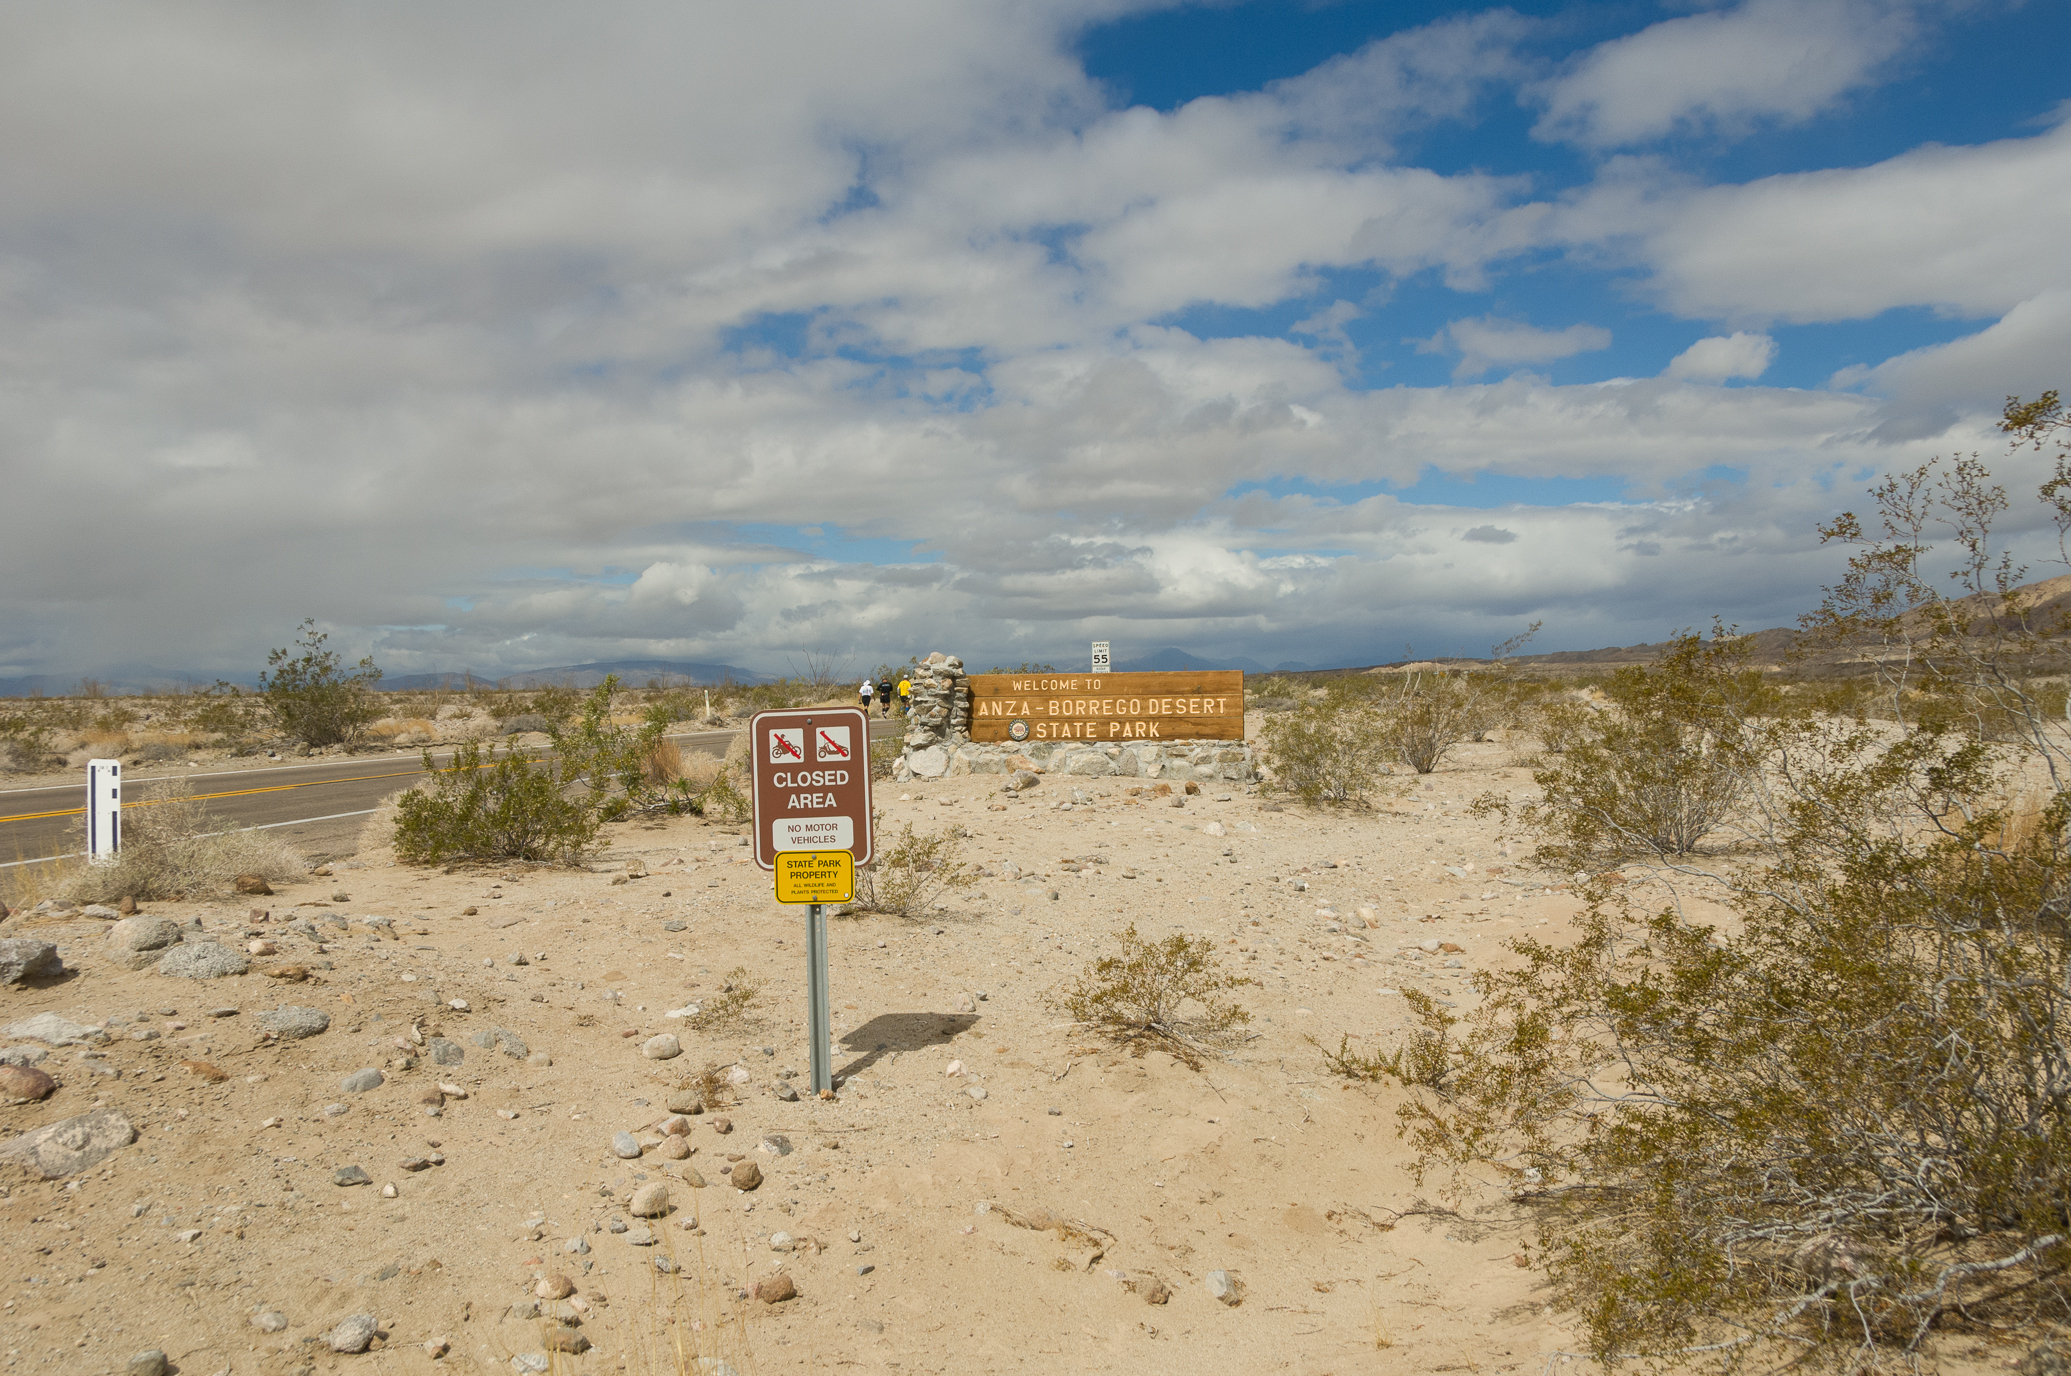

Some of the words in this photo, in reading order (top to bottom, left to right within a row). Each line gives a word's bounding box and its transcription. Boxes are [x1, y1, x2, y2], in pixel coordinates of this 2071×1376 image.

[1093, 654, 1108, 664] 55
[1013, 679, 1078, 691] WELCOME
[1085, 679, 1101, 690] TO
[1149, 698, 1227, 715] DESERT
[1036, 722, 1097, 738] STATE
[1109, 721, 1160, 738] PARK
[773, 769, 849, 788] CLOSED
[787, 792, 837, 810] AREA
[787, 824, 802, 833] NO
[805, 823, 838, 832] MOTOR
[791, 835, 836, 844] VEHICLES
[786, 860, 814, 869] STATE
[817, 859, 842, 868] PARK
[789, 870, 839, 880] PROPERTY
